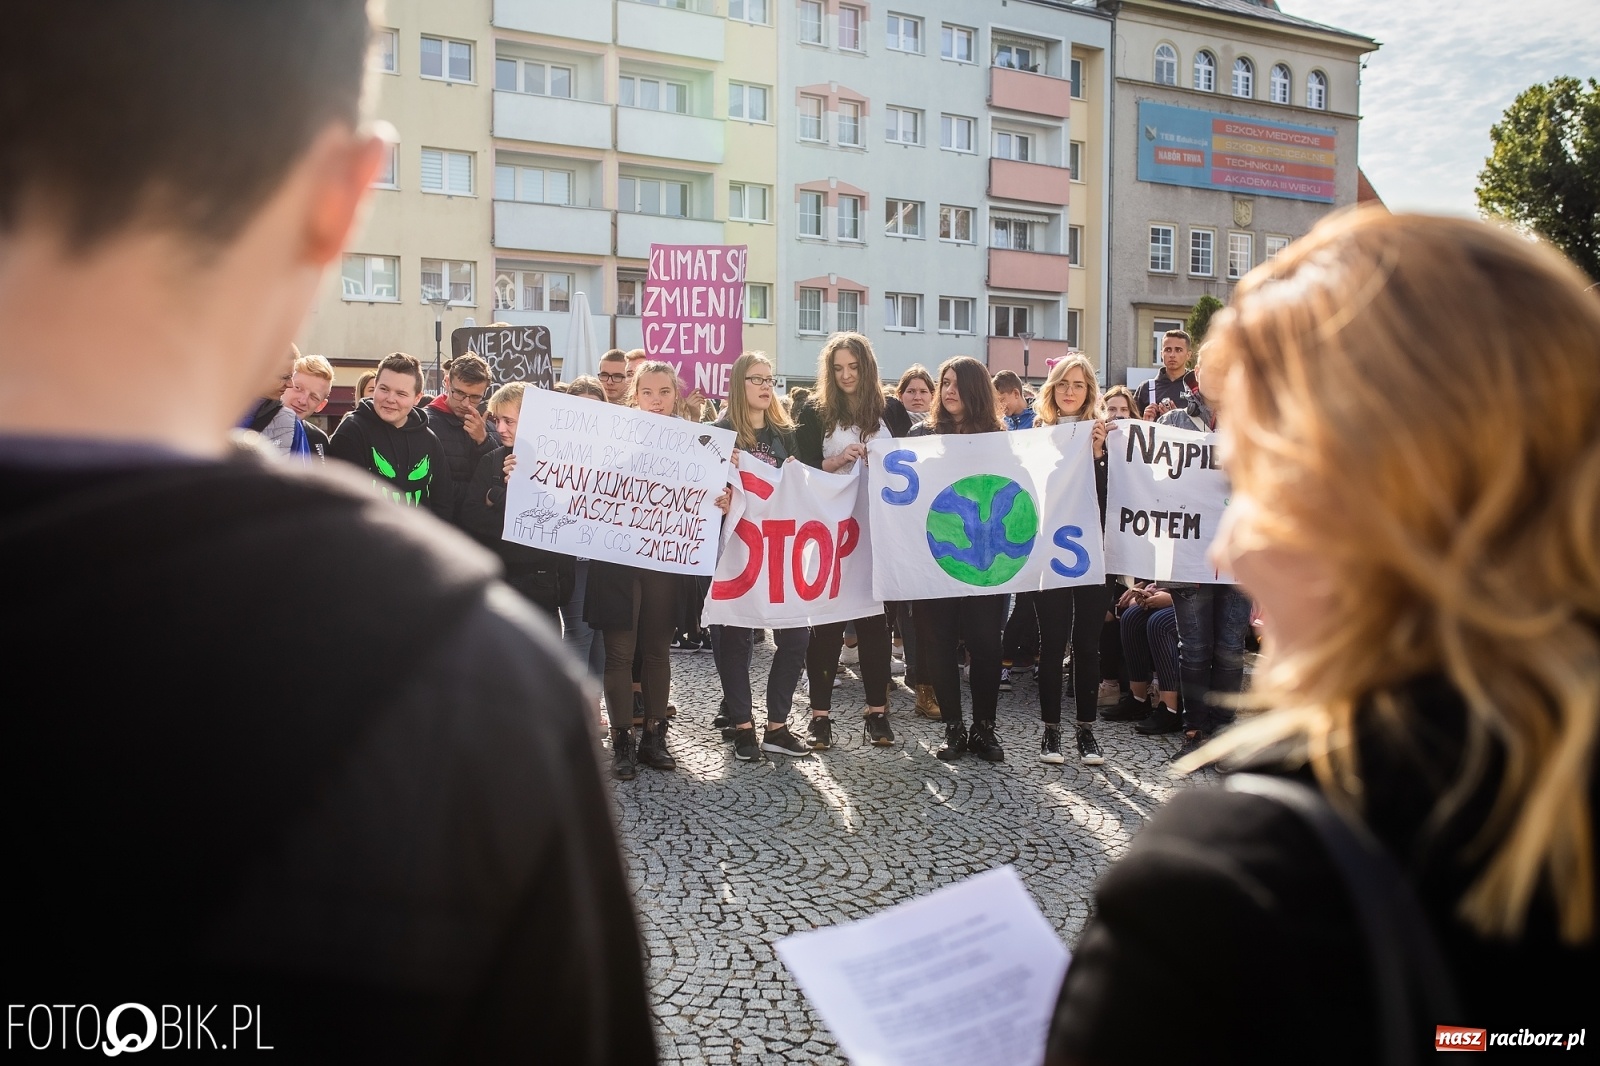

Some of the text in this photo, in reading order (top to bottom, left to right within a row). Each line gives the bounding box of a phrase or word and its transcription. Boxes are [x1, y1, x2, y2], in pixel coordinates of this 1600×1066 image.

[1225, 124, 1320, 146] SZKOŁY MEDYCZNE
[1225, 141, 1326, 162] SZKOŁY POLICEALNE
[1158, 150, 1202, 163] NABÓR TRWA
[1225, 157, 1285, 173] TECHNIKUM
[1224, 174, 1279, 189] AKADEMIA
[1288, 182, 1321, 194] WIEKU
[648, 248, 721, 281] KLIMAT
[467, 332, 496, 357] NIE
[646, 322, 725, 355] CZEMU
[694, 361, 733, 397] NIE
[550, 408, 599, 436] JEDYNA
[656, 425, 697, 455] KTÓRA
[536, 435, 706, 483] POWINNA BYĆ WIĘKSZA OD
[530, 460, 708, 515] ZMIAN KLIMATYCZNYCH
[532, 491, 707, 542] TO NASZE DZIAŁANIE
[1119, 506, 1201, 540] POTEM
[576, 524, 598, 546] BY
[636, 536, 700, 565] ZMIENIĆ
[711, 471, 860, 603] STOP
